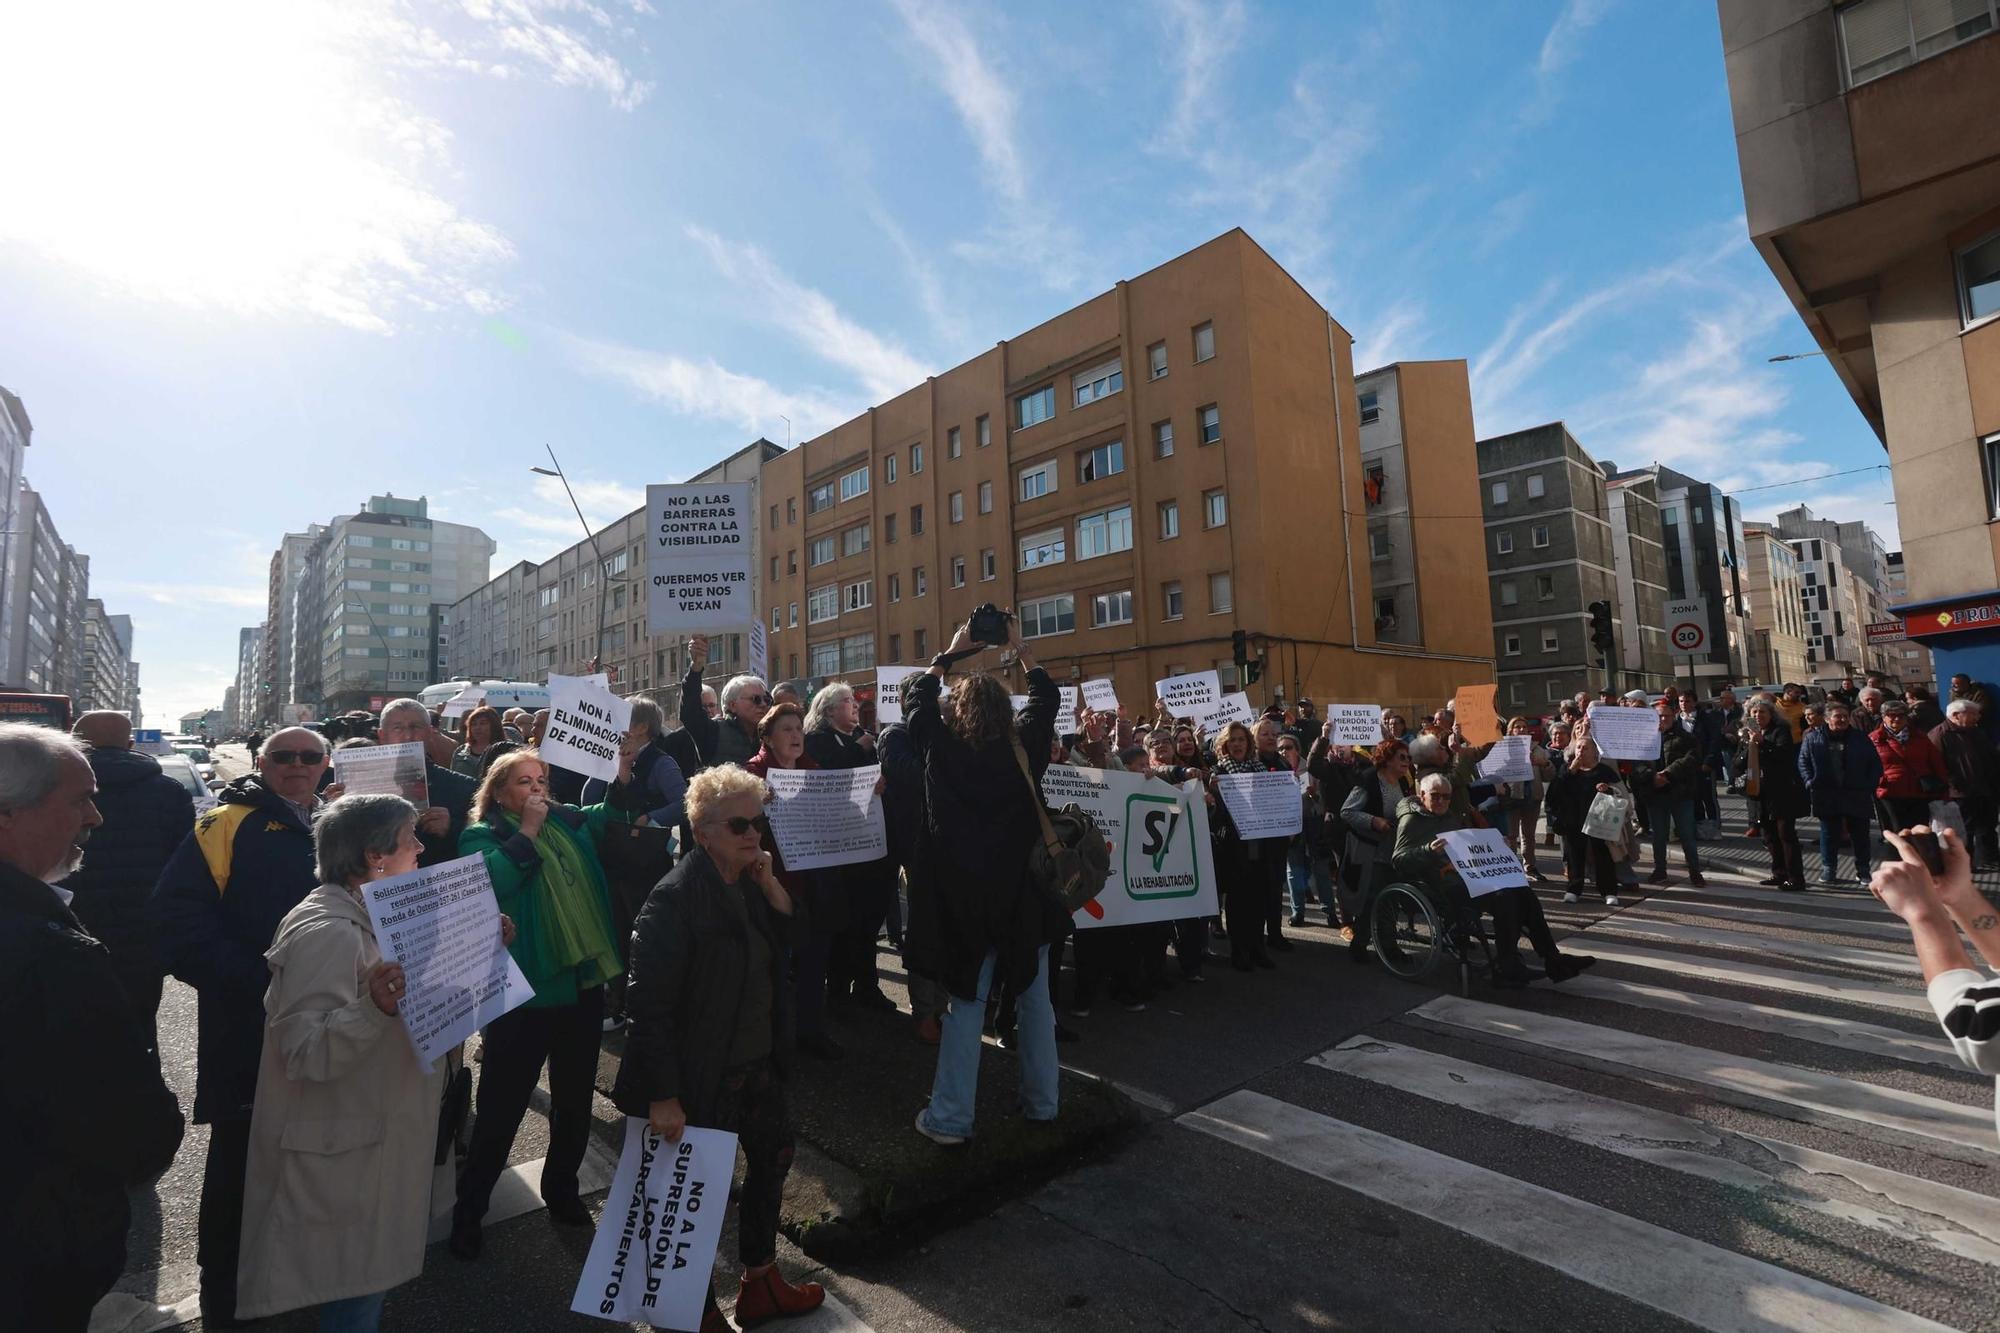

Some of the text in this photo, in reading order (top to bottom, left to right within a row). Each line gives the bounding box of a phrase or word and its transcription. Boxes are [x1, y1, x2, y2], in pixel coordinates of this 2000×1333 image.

[668, 494, 730, 506] NO A LAS
[663, 507, 736, 520] BARRERAS
[660, 520, 738, 533] CONTRA LA
[659, 534, 740, 546] VISIBILIDAD
[653, 572, 746, 586] QUEREMOS VER
[668, 586, 732, 599] E QUE NOS
[679, 600, 721, 612] VEXAN
[1672, 604, 1698, 614] ZONA
[1679, 632, 1696, 642] 30
[1193, 680, 1206, 688] UN
[1166, 688, 1212, 700] MURO QUE
[1168, 696, 1212, 707] NOS AÍSLE
[578, 700, 612, 724] NON Á
[1204, 706, 1242, 721] RETIRADA
[1217, 716, 1233, 726] DOS
[142, 730, 154, 742] L
[548, 727, 615, 761] DE ACCESOS
[1057, 788, 1065, 796] DE
[1066, 790, 1090, 798] PLAZAS
[1468, 844, 1486, 854] NON
[1456, 854, 1515, 869] ELIMINACIÓN
[1467, 866, 1522, 880] DE ACCESOS
[373, 880, 418, 900] Solicitamos
[420, 876, 426, 888] la
[426, 868, 462, 885] modificación
[1130, 872, 1194, 888] A LA REHABILITACIÓN
[390, 886, 438, 909] reurbanización
[439, 883, 448, 893] del
[448, 877, 468, 892] espacio
[380, 912, 406, 926] Ronda
[407, 908, 415, 917] de
[416, 900, 438, 914] Outeiro
[390, 931, 400, 942] NO
[393, 942, 404, 954] NO
[600, 1133, 660, 1315] PARCAMIENTOS
[638, 1196, 658, 1241] LOS
[642, 1142, 692, 1308] SUPRESIÓN DE
[672, 1180, 704, 1270] NO A LA
